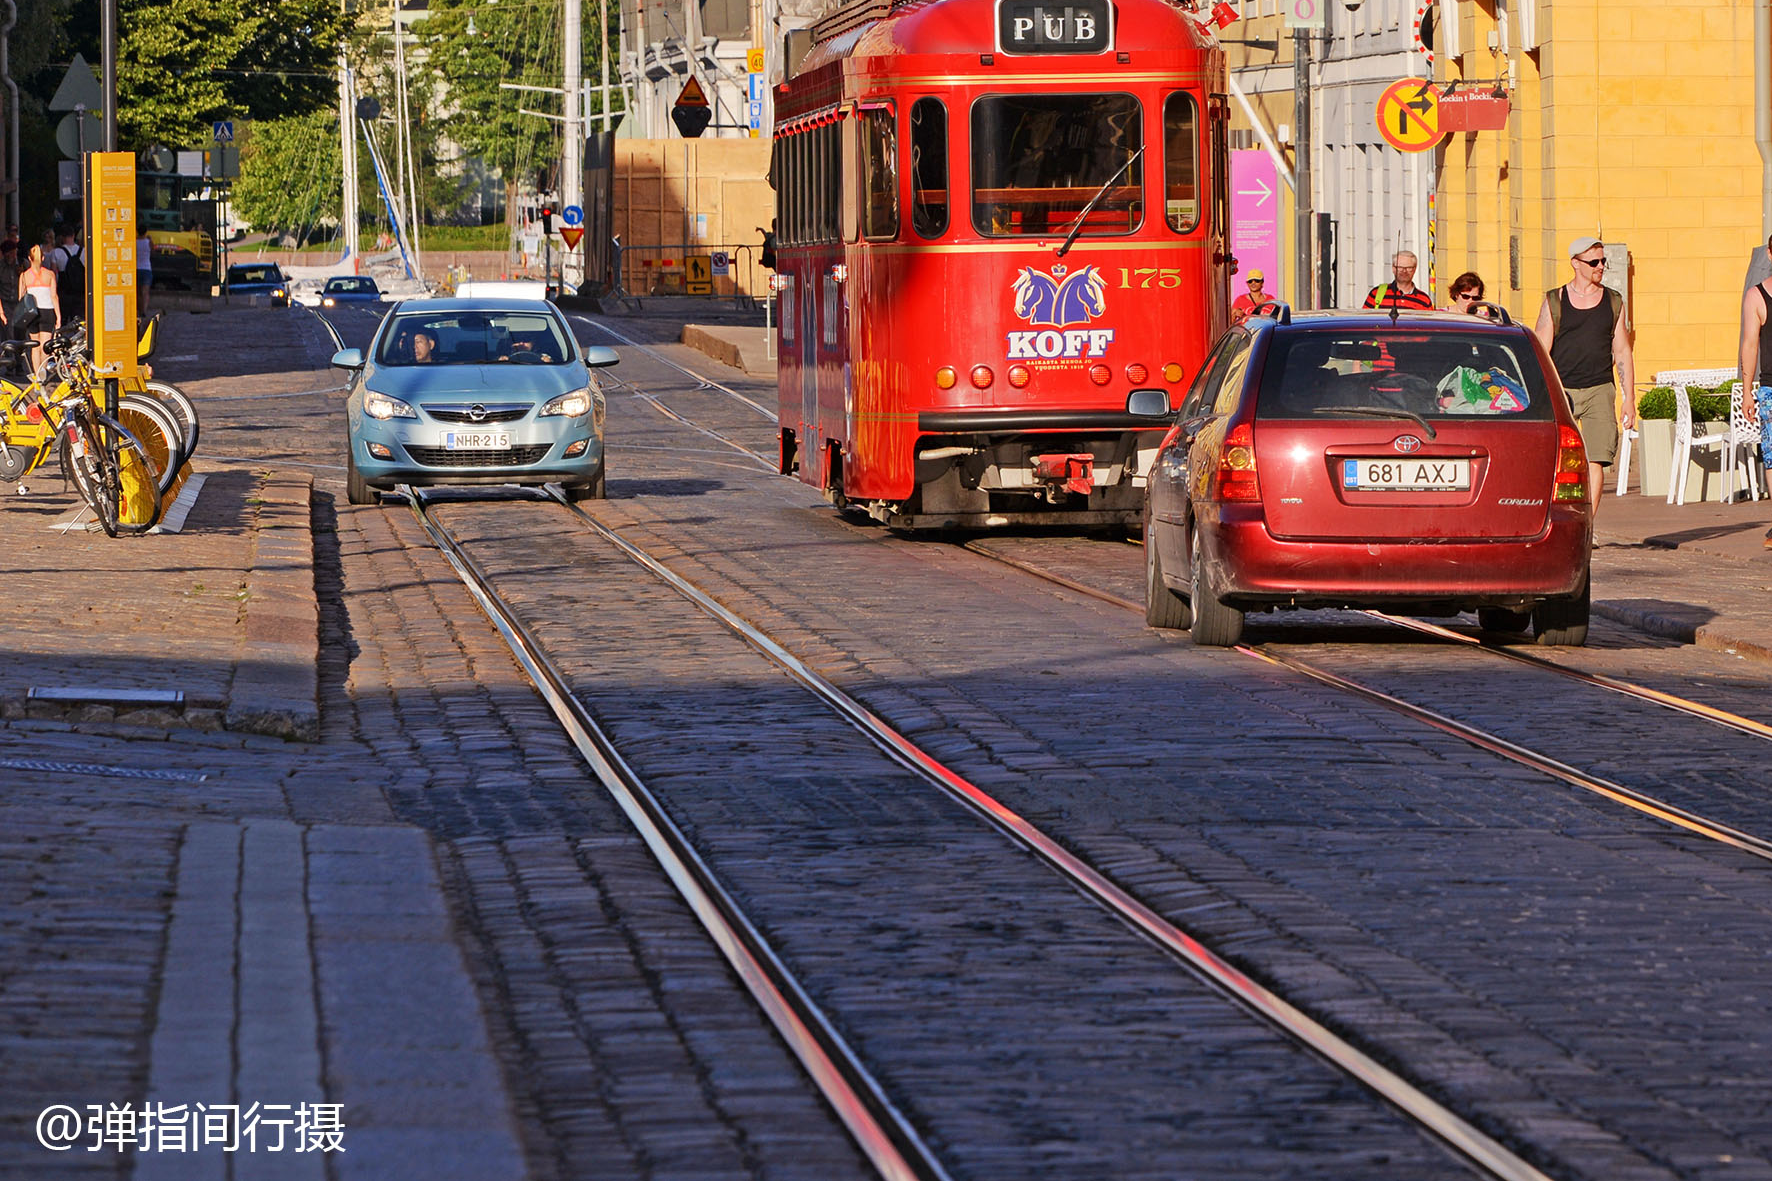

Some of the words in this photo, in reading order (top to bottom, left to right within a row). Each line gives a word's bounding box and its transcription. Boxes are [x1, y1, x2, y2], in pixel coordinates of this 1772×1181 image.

[1014, 17, 1096, 40] PUB
[1117, 268, 1182, 289] 175
[1007, 329, 1114, 358] KOFF
[1368, 464, 1402, 484] 681
[1414, 464, 1458, 484] AXJ
